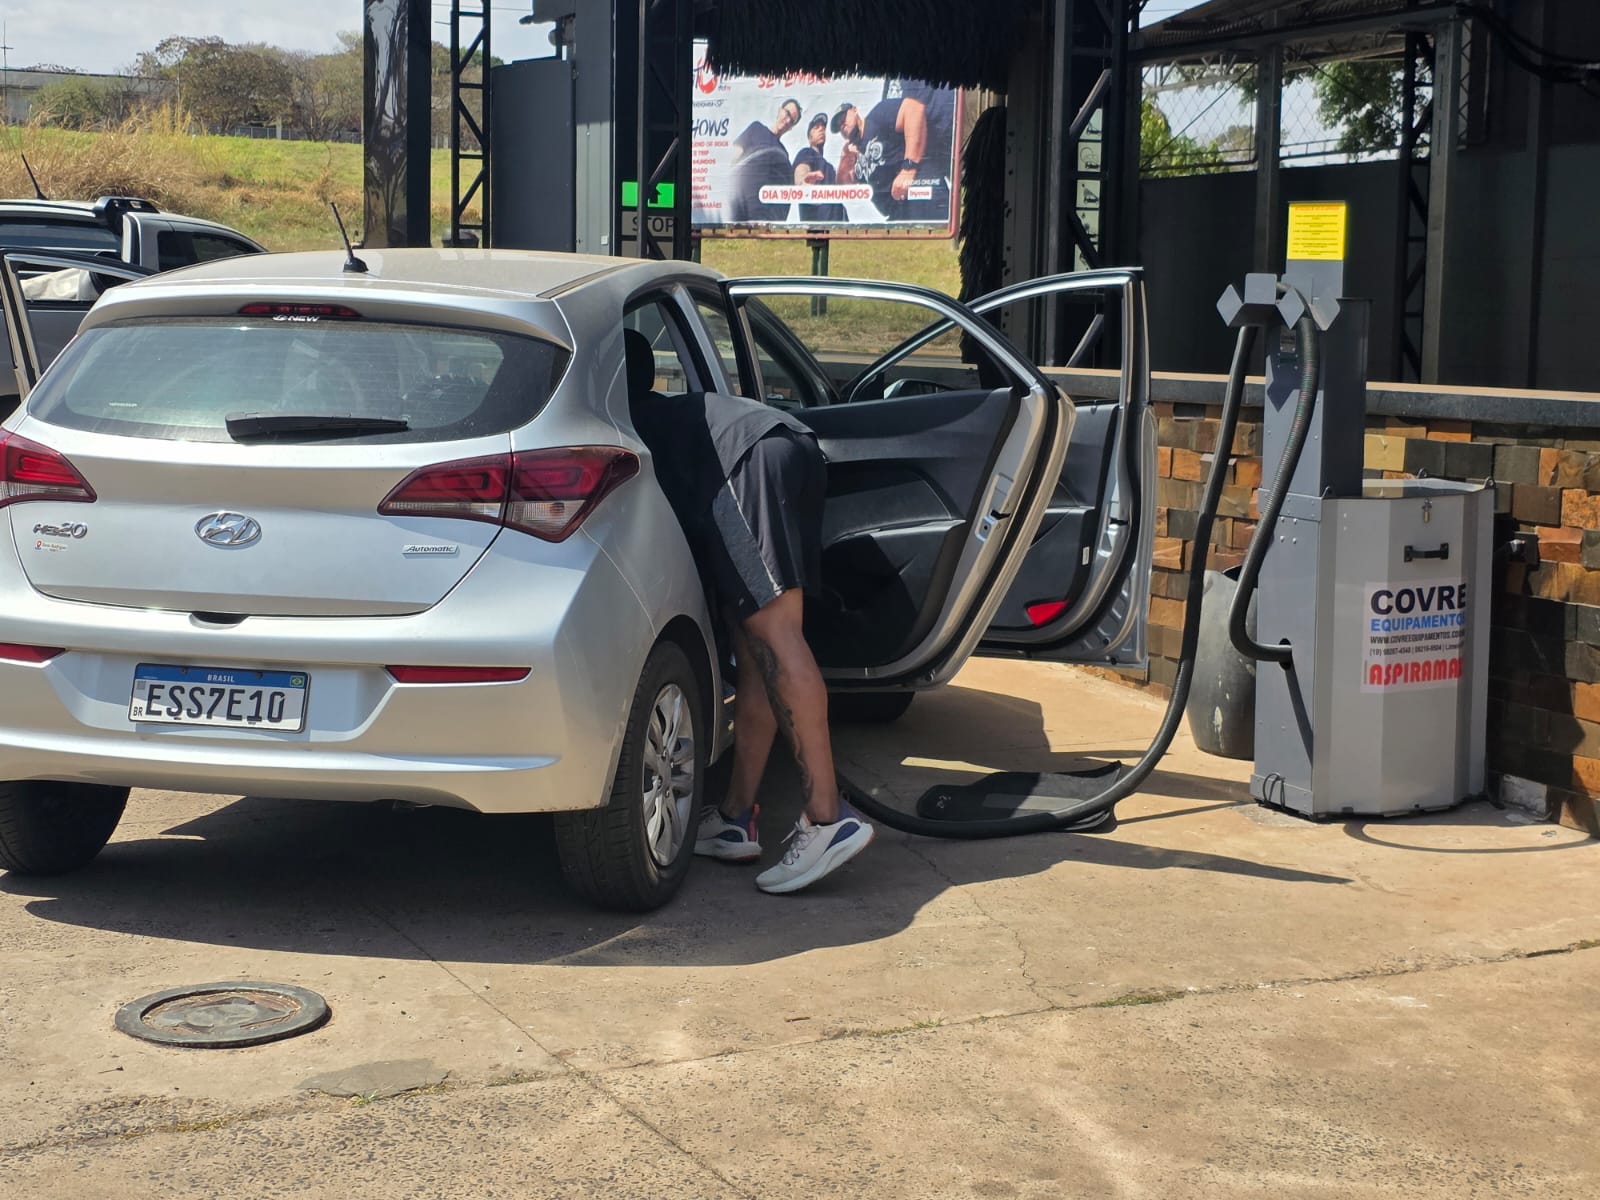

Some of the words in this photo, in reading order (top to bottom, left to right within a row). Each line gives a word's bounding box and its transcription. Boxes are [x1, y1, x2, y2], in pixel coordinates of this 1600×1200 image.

[692, 118, 730, 139] HOWS
[762, 190, 778, 200] DIA
[780, 189, 803, 201] 19/09
[811, 188, 870, 200] RAIMUNDOS
[632, 216, 674, 233] SOP
[406, 545, 454, 553] Automatic
[1370, 583, 1466, 615] COVRE
[207, 674, 235, 683] BRASIL
[145, 684, 286, 723] ESS7E10
[132, 706, 143, 717] BR
